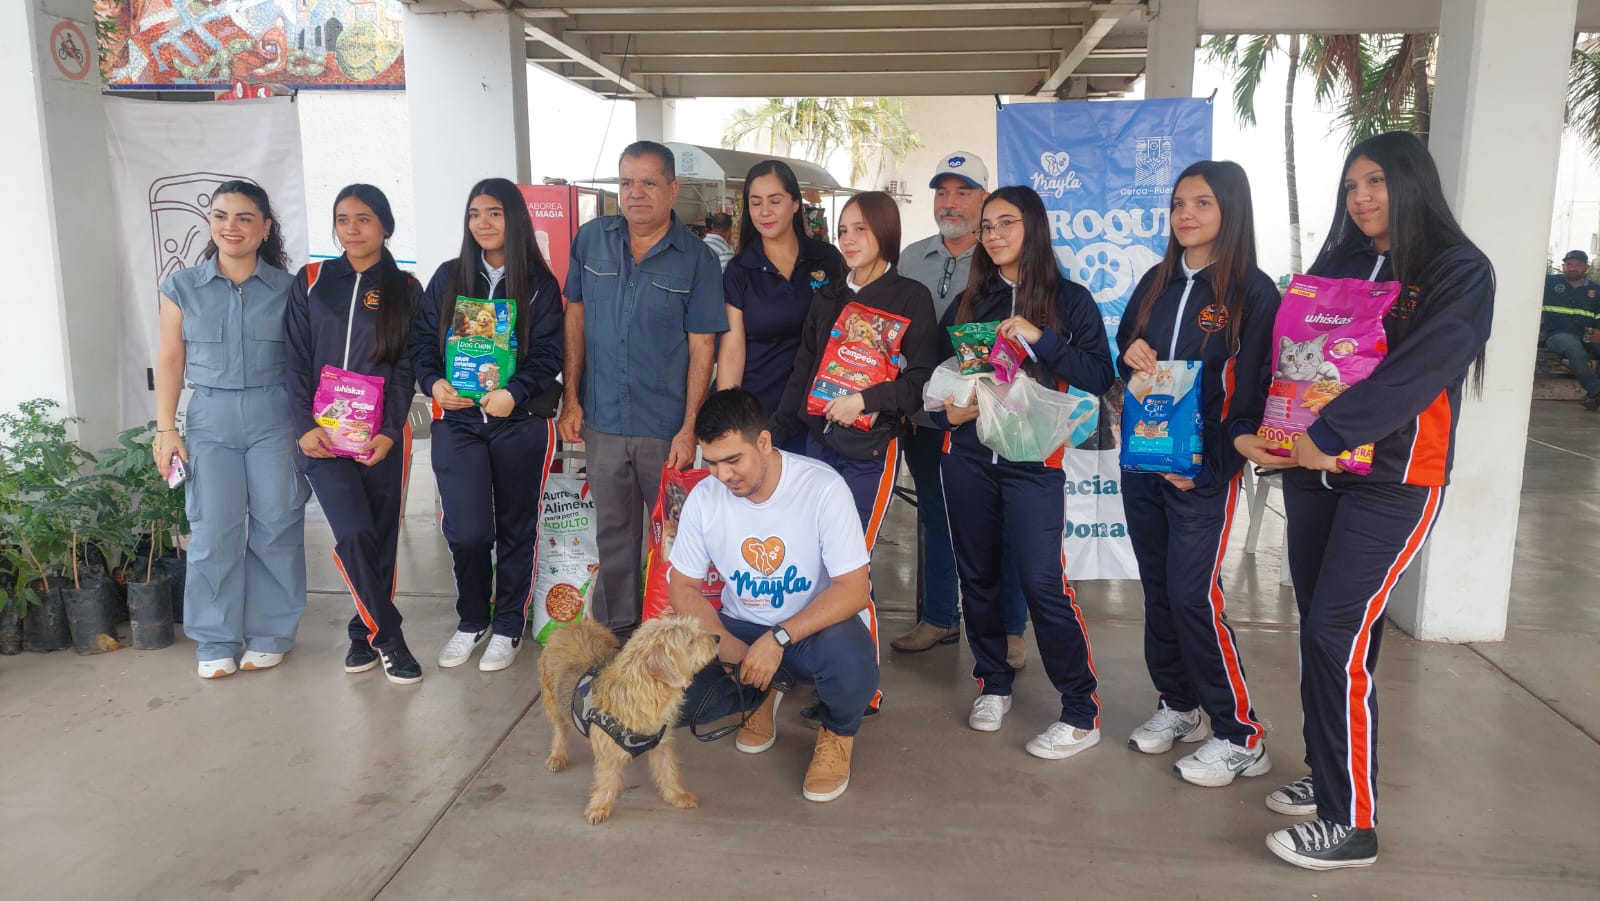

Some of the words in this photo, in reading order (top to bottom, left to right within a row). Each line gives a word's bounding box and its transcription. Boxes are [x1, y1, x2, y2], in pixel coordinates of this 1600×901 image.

[1030, 170, 1081, 198] Mayla
[527, 202, 563, 210] ABOREA
[535, 210, 564, 218] MAGIA
[1049, 208, 1171, 243] ROQU
[1103, 315, 1121, 326] 25
[1304, 312, 1354, 325] whiskas
[474, 342, 491, 350] CHOW
[841, 346, 877, 365] Campeón
[334, 385, 366, 396] whiskas
[1065, 474, 1119, 495] acia
[544, 500, 595, 514] Aliment
[562, 511, 579, 520] perro
[544, 517, 589, 528] ADULTO
[1064, 519, 1126, 538] Dona
[729, 565, 812, 608] Mayla
